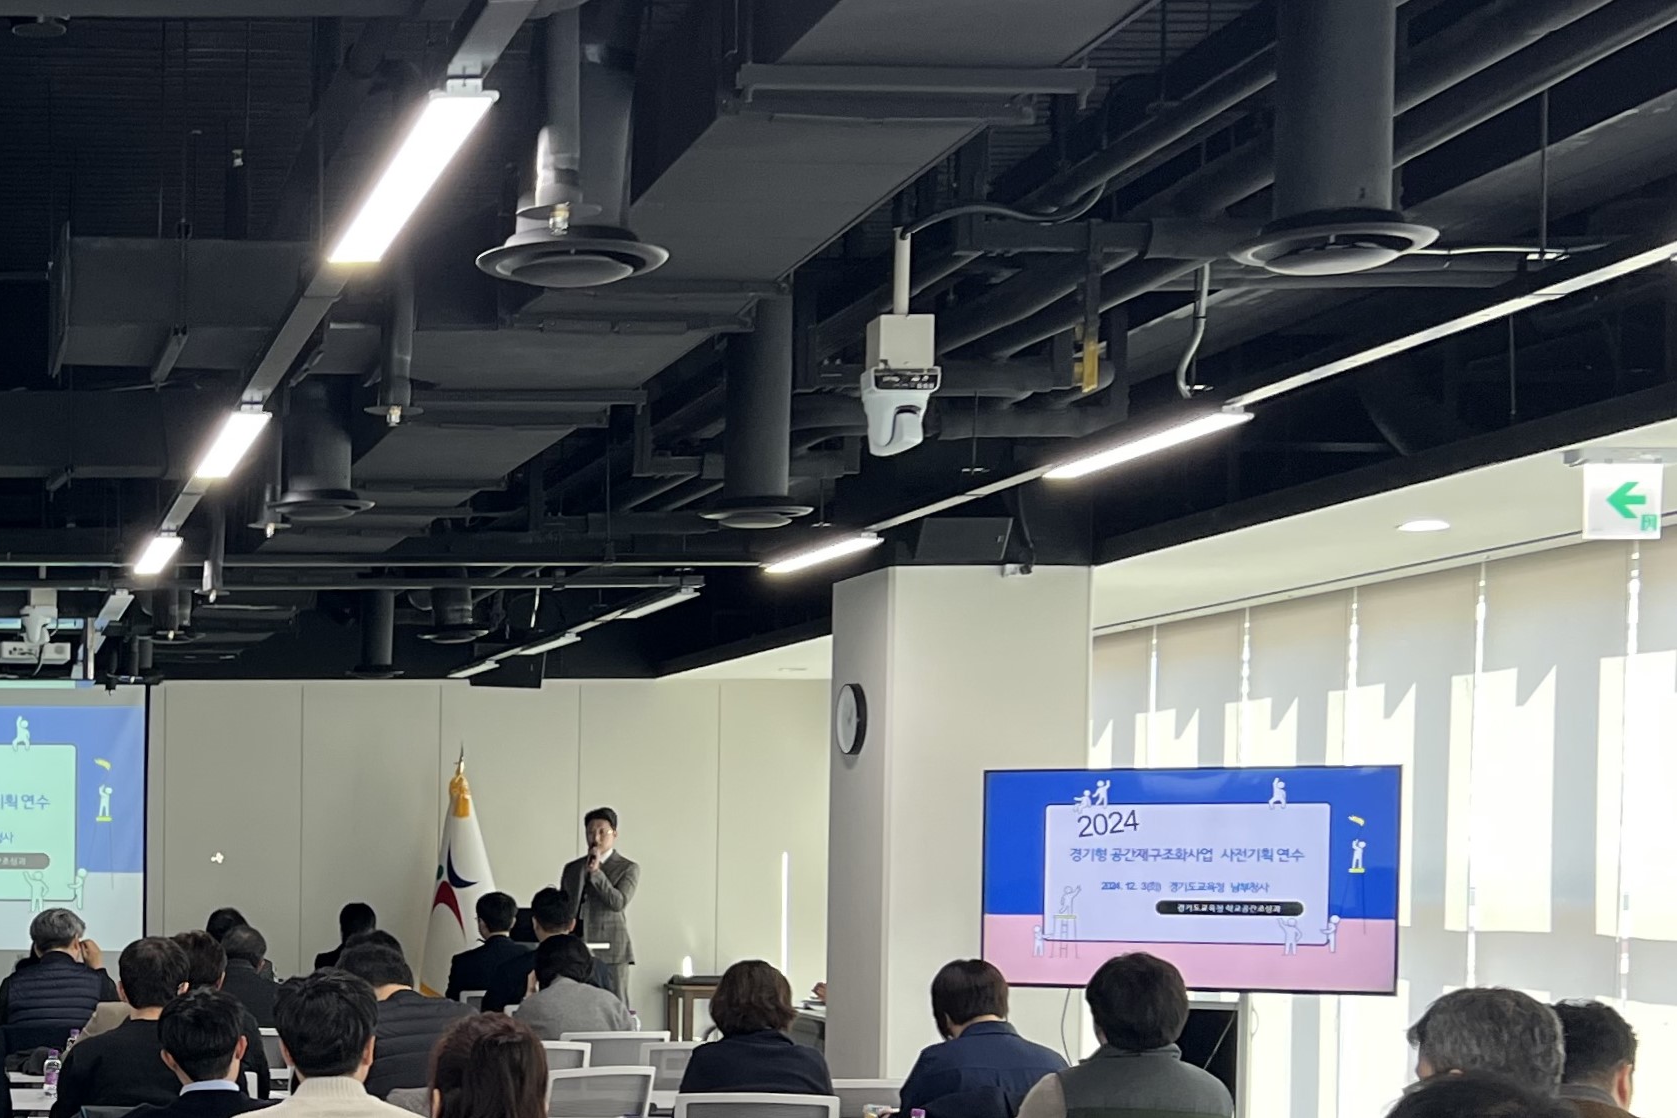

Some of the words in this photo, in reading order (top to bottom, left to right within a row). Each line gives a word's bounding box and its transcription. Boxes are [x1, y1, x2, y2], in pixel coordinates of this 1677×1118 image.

[20, 794, 51, 811] 연수
[1077, 809, 1140, 838] 2024
[1069, 847, 1108, 862] 경기형
[1110, 847, 1214, 863] 공간재구조화사업
[1220, 847, 1274, 863] 사전기획
[1276, 848, 1306, 863] 연수
